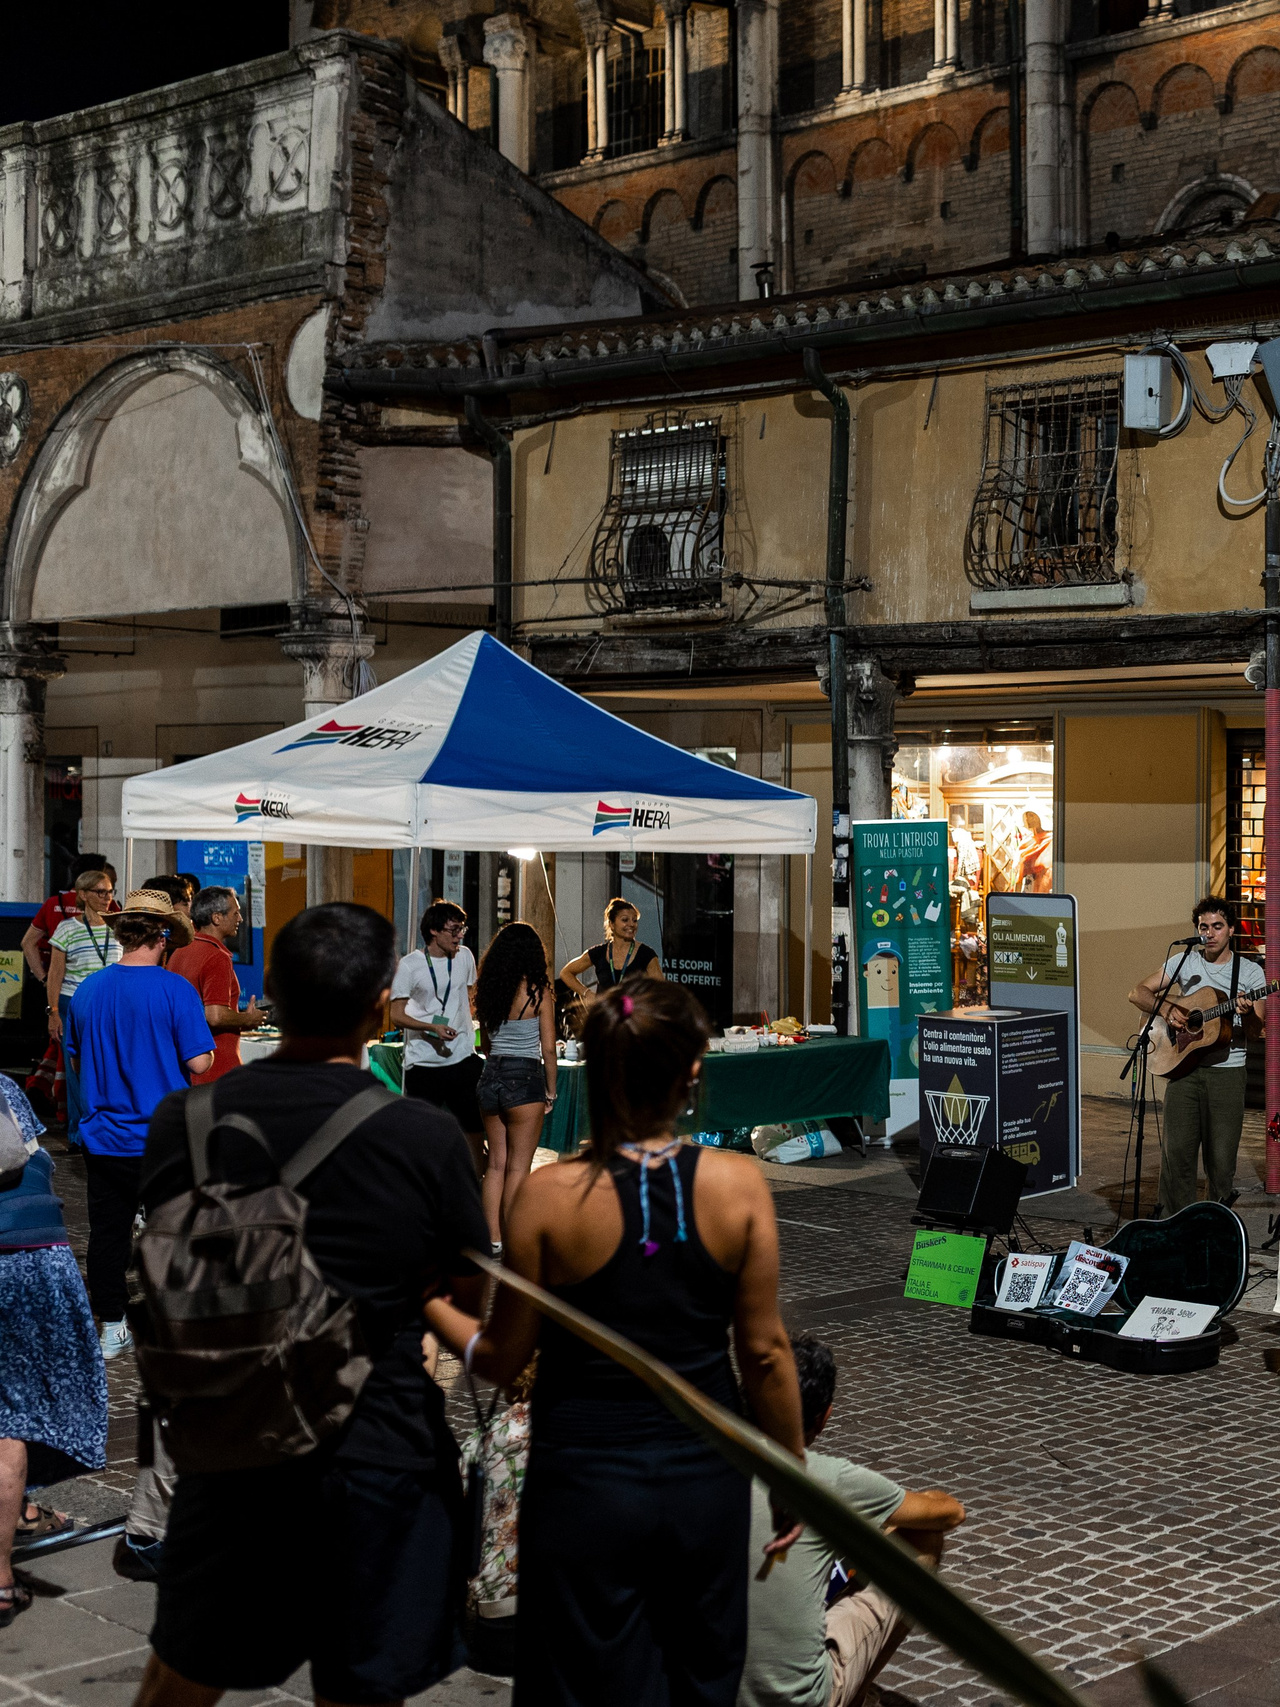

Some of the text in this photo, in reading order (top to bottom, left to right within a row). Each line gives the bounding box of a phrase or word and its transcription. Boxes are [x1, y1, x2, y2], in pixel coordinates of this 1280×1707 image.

[338, 726, 421, 750] HERA
[260, 799, 294, 819] HERA
[636, 800, 670, 808] GRUPPO
[632, 808, 670, 830] HERA
[862, 831, 939, 848] TROVA L'INTRUSO
[880, 848, 924, 859] NELLA PLASTICA
[992, 932, 1046, 943] OLI ALIMENTARI
[671, 958, 677, 969] E
[679, 959, 713, 971] SCOPRI
[680, 973, 722, 987] OFFERTE
[923, 1028, 986, 1043] Centra il contenitore!
[923, 1040, 992, 1056] L'olio alimentare usato
[923, 1052, 978, 1067] ha una nuova vita.
[1037, 1080, 1064, 1090] biocarburante
[1003, 1126, 1020, 1134] raccolta
[1016, 1130, 1037, 1138] alimentare
[1086, 1248, 1102, 1259] scan
[912, 1258, 947, 1271] STRAWMAN
[953, 1265, 976, 1276] CELINE
[1021, 1260, 1046, 1269] satispay
[908, 1278, 931, 1289] ITALIA E
[906, 1286, 939, 1298] MONGOLIA
[1151, 1306, 1196, 1318] THANK YOU
